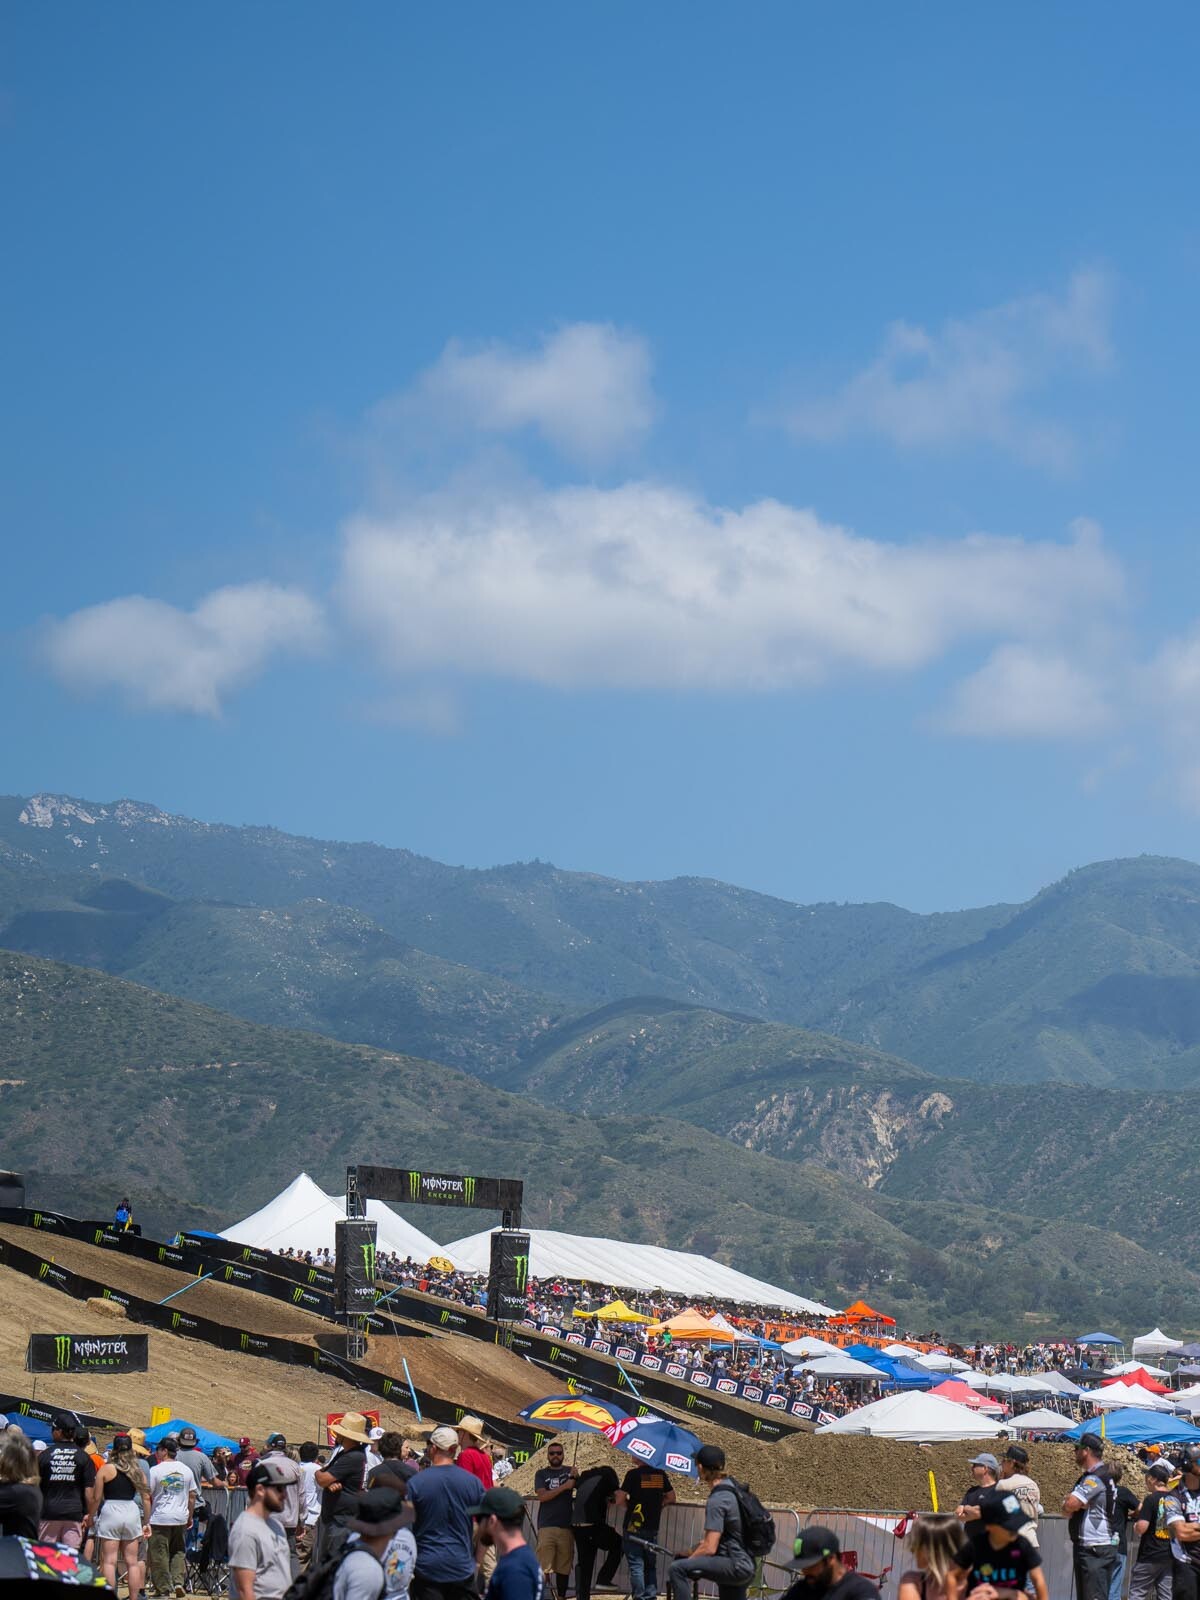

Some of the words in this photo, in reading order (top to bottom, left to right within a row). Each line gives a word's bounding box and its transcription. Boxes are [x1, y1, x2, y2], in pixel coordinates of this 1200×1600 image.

[422, 1177, 463, 1192] MONSTER
[74, 1340, 128, 1357] MONSTER
[631, 1440, 651, 1456] 100%
[669, 1456, 689, 1469] 100%
